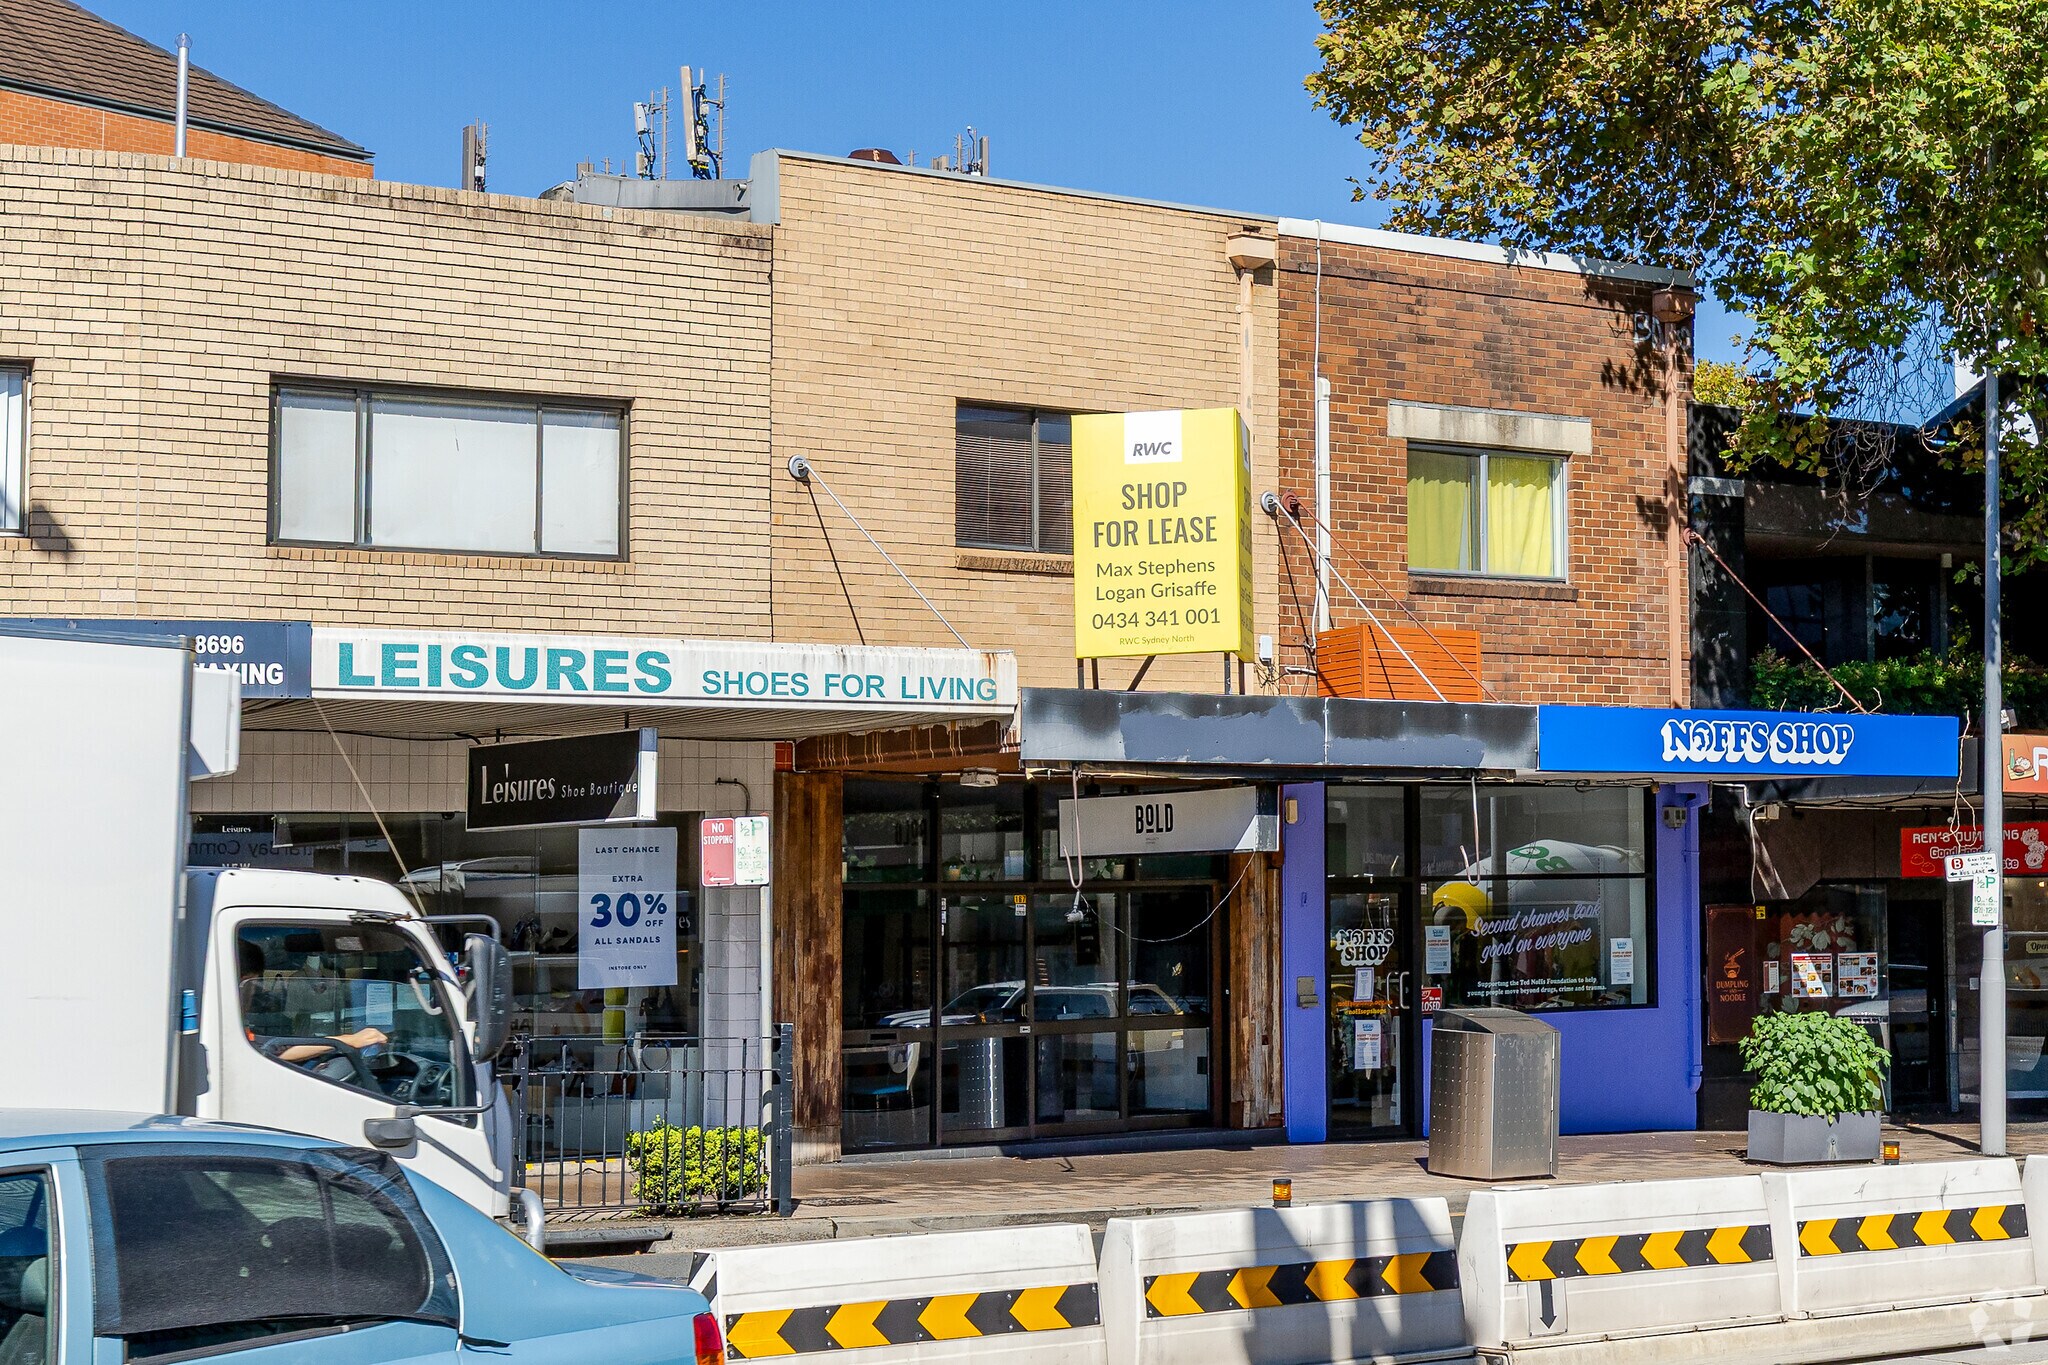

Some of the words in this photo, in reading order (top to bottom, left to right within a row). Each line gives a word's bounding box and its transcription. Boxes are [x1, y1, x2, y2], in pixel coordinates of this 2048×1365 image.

[1132, 441, 1172, 457] RWC
[1121, 481, 1187, 511] SHOP
[1093, 519, 1139, 548] FOR
[1148, 516, 1217, 545] LEASE
[1096, 562, 1133, 577] Max
[1138, 558, 1216, 579] Stephens
[1095, 585, 1146, 603] Logan
[1151, 581, 1217, 598] Grisaffe
[1092, 611, 1140, 630] 0434
[1145, 609, 1180, 627] 341
[1185, 607, 1220, 625] 001
[195, 634, 245, 654] 8696
[1119, 637, 1140, 645] RWC
[1141, 636, 1170, 646] Sydney
[1171, 634, 1195, 643] North
[338, 642, 672, 693] LEISURES
[702, 670, 809, 697] SHOES
[824, 673, 886, 698] FOR
[901, 675, 997, 701] LIVING
[1663, 719, 1769, 758] NOFFS
[1771, 722, 1854, 760] SHOP
[481, 763, 556, 805] Leisures
[561, 784, 586, 799] Shoe
[589, 781, 638, 797] Boutique
[711, 823, 725, 833] NO
[1135, 803, 1174, 834] BOLD
[221, 825, 252, 833] Leisures
[703, 835, 733, 845] STOPPING
[590, 893, 667, 927] 30%
[1470, 911, 1521, 937] Second
[1520, 907, 1570, 929] chances
[1573, 900, 1600, 919] look
[645, 919, 664, 927] OFF
[616, 936, 661, 944] SANDALS
[1338, 929, 1394, 946] NOFFS
[1479, 935, 1516, 964] good
[1515, 940, 1533, 952] on
[1535, 927, 1592, 950] everyone
[1343, 945, 1390, 962] SHOP
[1485, 988, 1504, 997] people
[1716, 980, 1749, 989] DUMPLING
[1422, 1001, 1441, 1012] LOSED
[1720, 993, 1746, 1001] NOODLE
